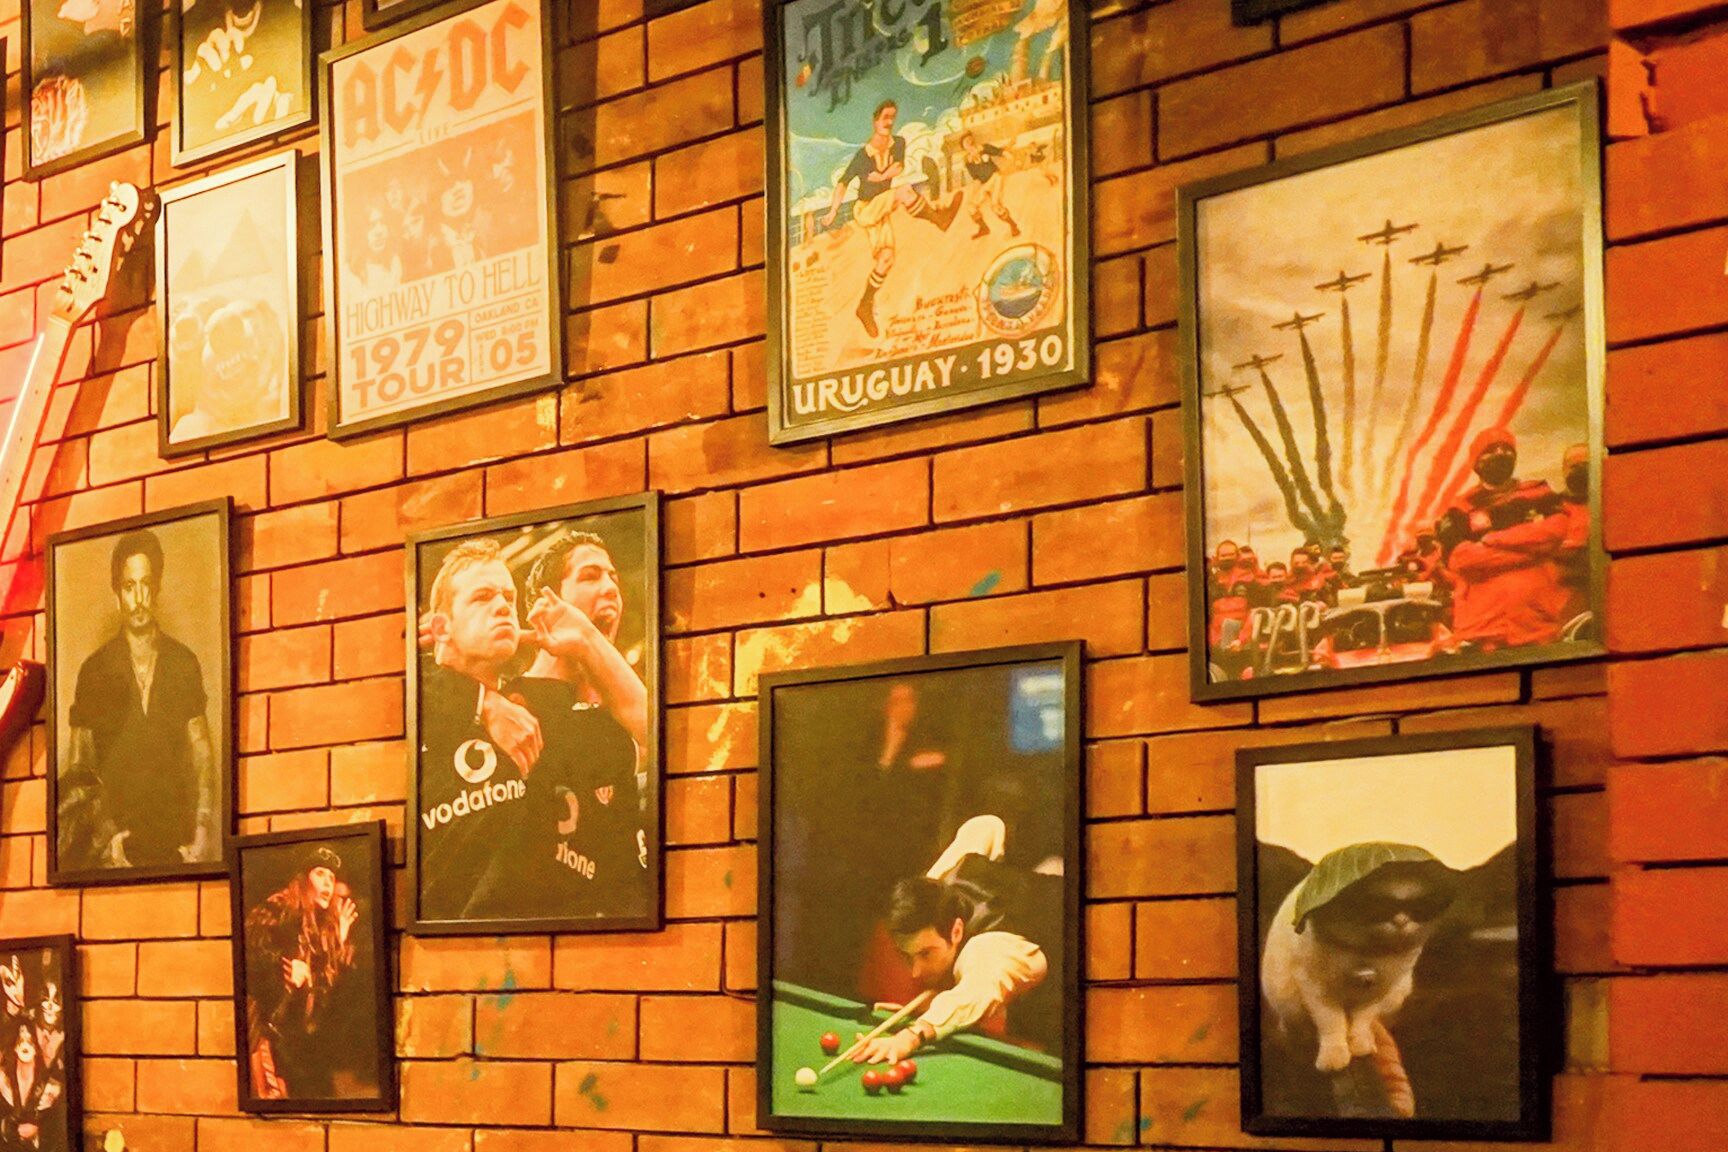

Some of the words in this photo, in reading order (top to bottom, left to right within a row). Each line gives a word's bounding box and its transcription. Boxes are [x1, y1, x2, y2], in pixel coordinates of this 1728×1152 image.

[346, 279, 436, 340] HIGHWAY
[444, 270, 475, 310] TO
[482, 253, 541, 298] HELL
[475, 302, 520, 323] OAKLAND
[350, 319, 466, 380] 1979
[490, 330, 537, 372] 05
[793, 352, 952, 415] URUGUAY
[978, 335, 1062, 379] 1930
[352, 355, 465, 409] TOUR
[422, 778, 527, 831] vodafone
